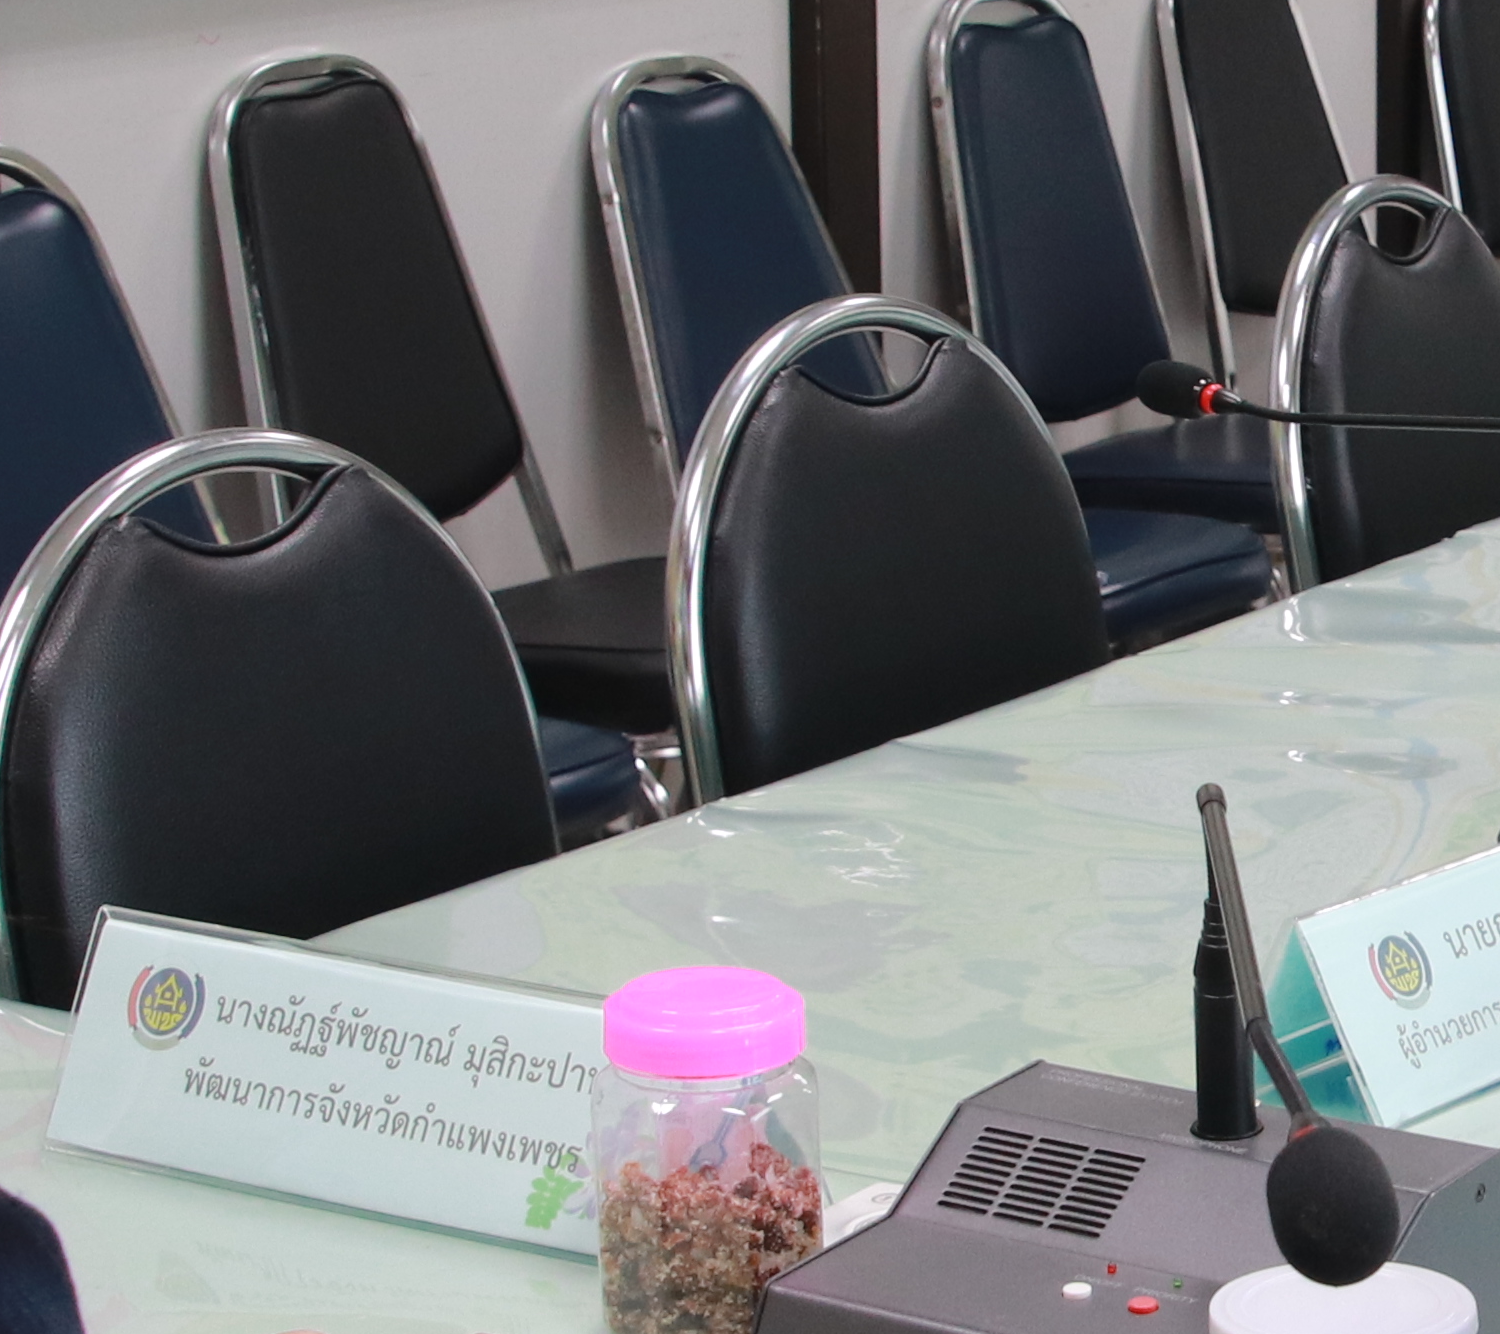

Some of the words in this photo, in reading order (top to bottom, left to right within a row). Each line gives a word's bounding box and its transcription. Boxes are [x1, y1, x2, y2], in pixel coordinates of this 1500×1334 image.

[184, 1056, 584, 1174] พัฒนาการจังหวัดกำแพงเพชร
